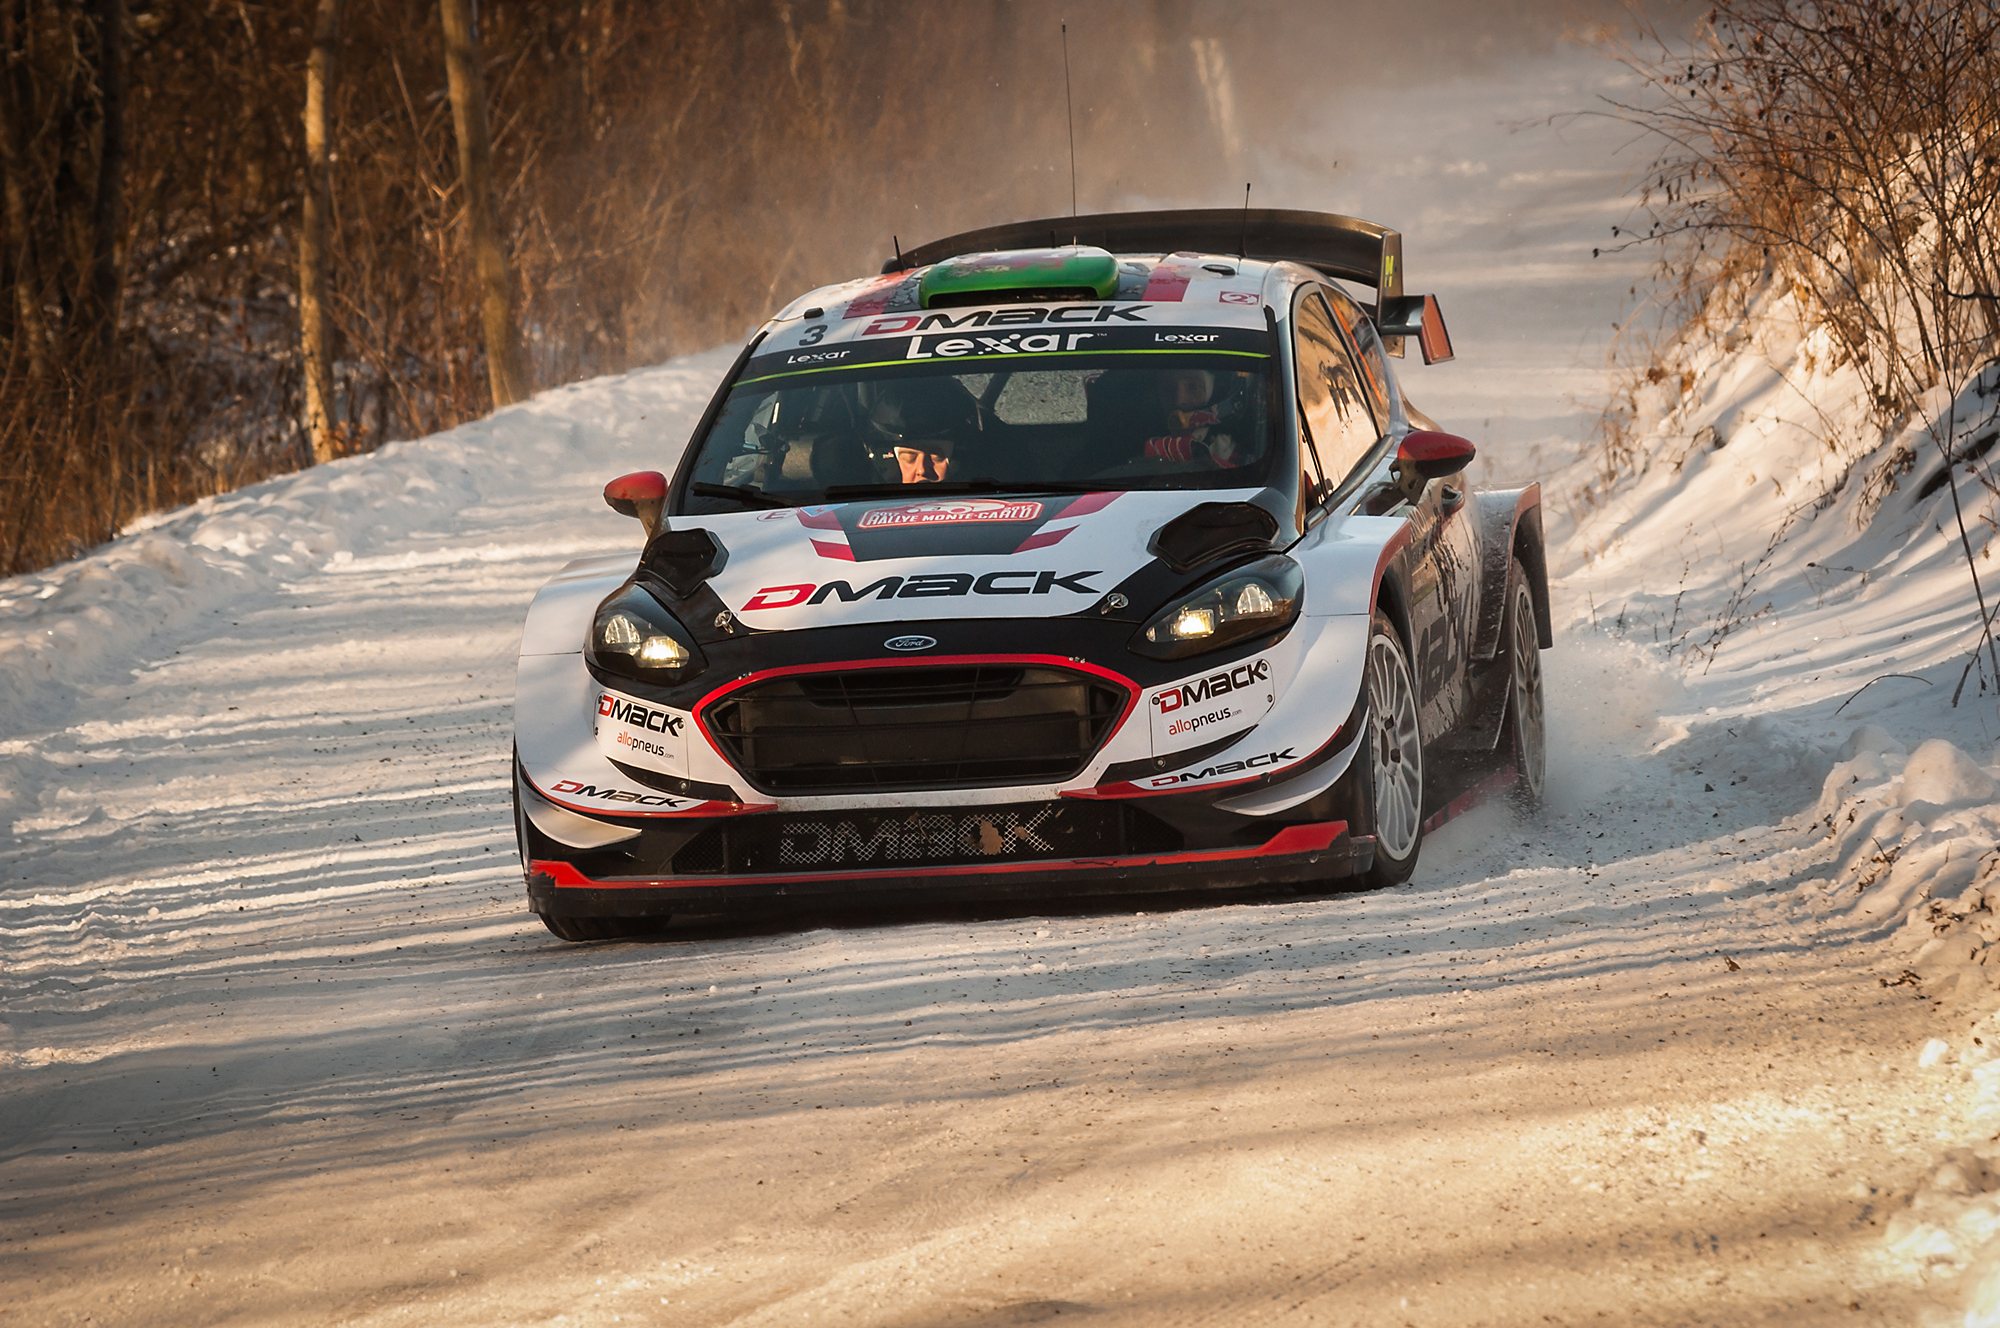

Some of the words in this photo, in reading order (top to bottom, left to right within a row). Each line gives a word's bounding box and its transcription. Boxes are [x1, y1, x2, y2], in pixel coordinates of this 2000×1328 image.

[862, 304, 1153, 336] DMACK
[799, 324, 828, 346] 3
[906, 333, 1094, 359] Lexar
[1155, 332, 1219, 342] Lexar
[787, 350, 850, 364] Lexar
[866, 514, 919, 525] RALLYE
[922, 506, 1033, 522] MONTE-CARLO
[740, 571, 1104, 612] DMACK
[895, 638, 925, 647] Ford
[1160, 659, 1268, 714] DMACK
[598, 694, 680, 737] DMACK
[1151, 747, 1299, 787] DMACK
[550, 780, 687, 807] DMACK
